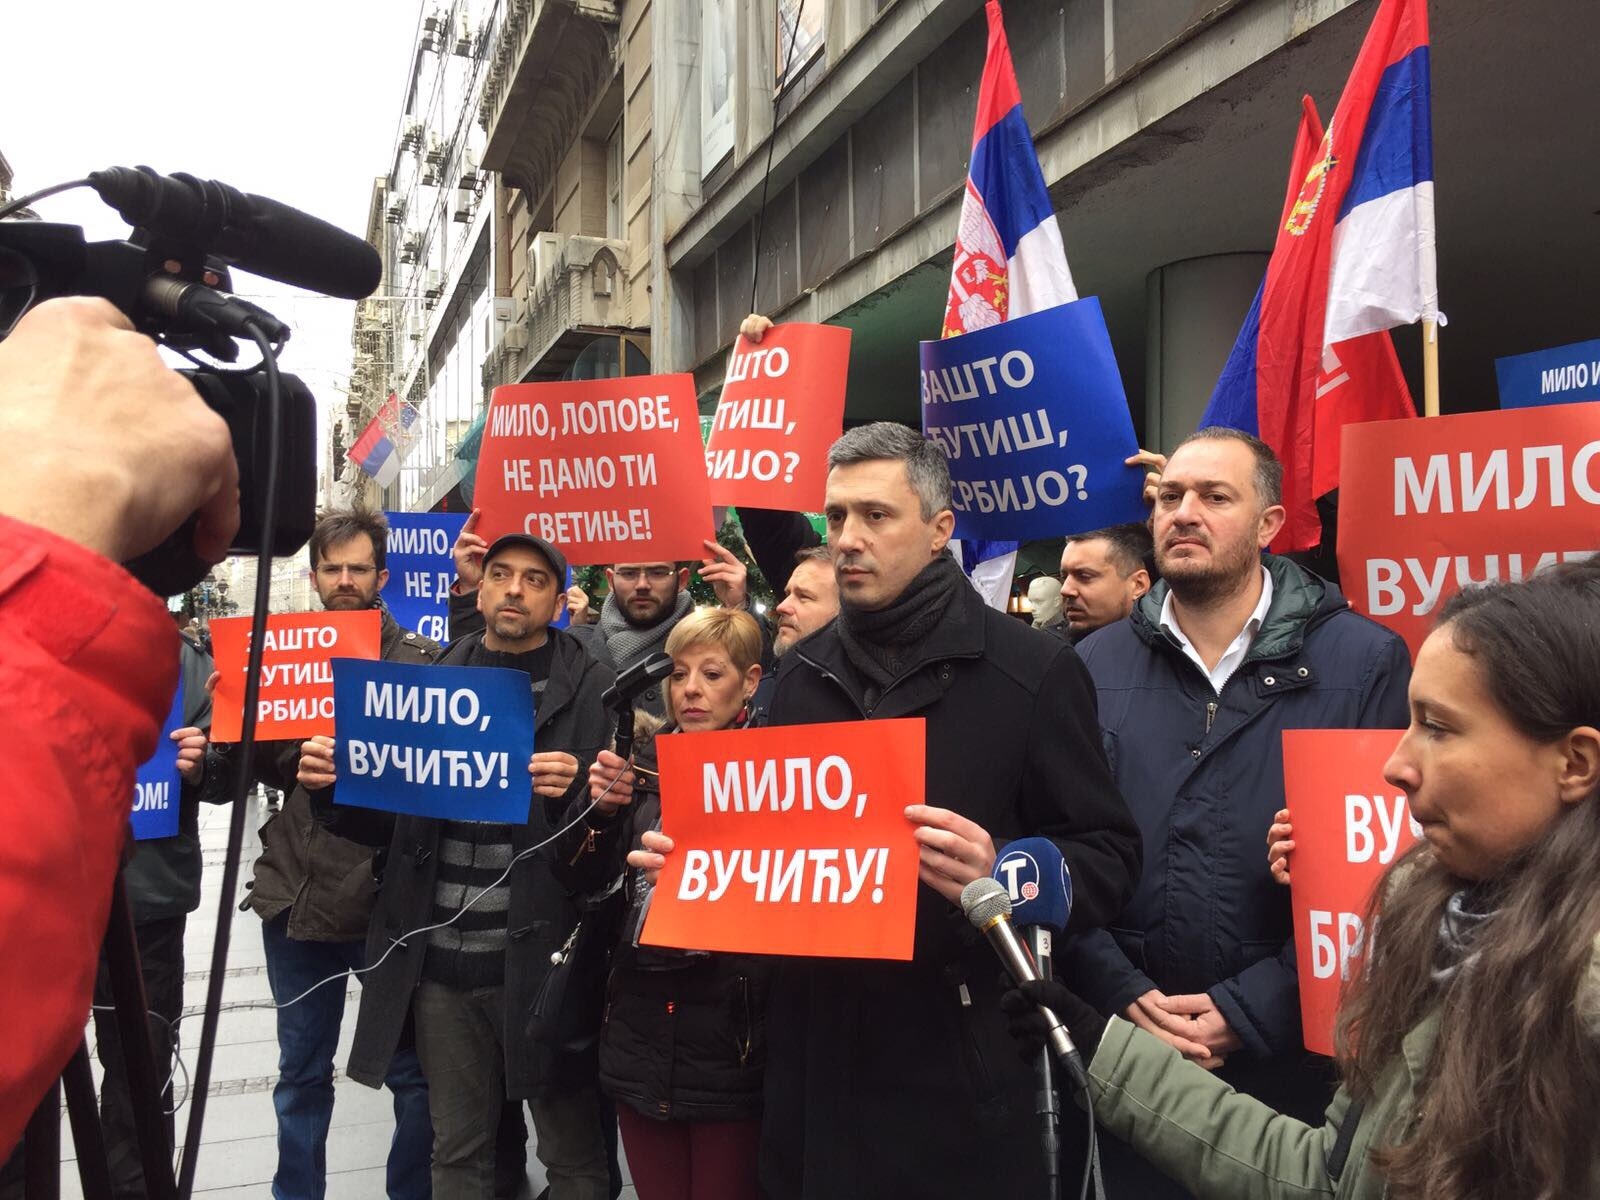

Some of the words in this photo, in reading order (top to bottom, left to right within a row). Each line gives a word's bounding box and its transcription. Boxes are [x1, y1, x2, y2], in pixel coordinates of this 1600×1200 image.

[921, 350, 1035, 405] ЗАШТО
[1541, 363, 1589, 395] МИЛО
[491, 403, 556, 440] МИЛО,
[562, 395, 680, 436] ЛОПОВЕ,
[927, 408, 1068, 460] ЋУТИШ,
[503, 459, 534, 491] НЕ
[539, 456, 616, 498] ДАМО
[619, 453, 658, 487] ТИ
[524, 509, 653, 544] СВЕТИЊЕ!
[404, 571, 432, 598] НЕ
[436, 572, 459, 605] Д
[1366, 550, 1600, 616] ВУЧ
[242, 696, 335, 723] РБИЈО
[364, 680, 492, 732] МИЛО,
[348, 739, 509, 789] ВУЧИЋУ!
[703, 755, 868, 818] МИЛО,
[677, 848, 890, 904] ВУЧИЋУ!
